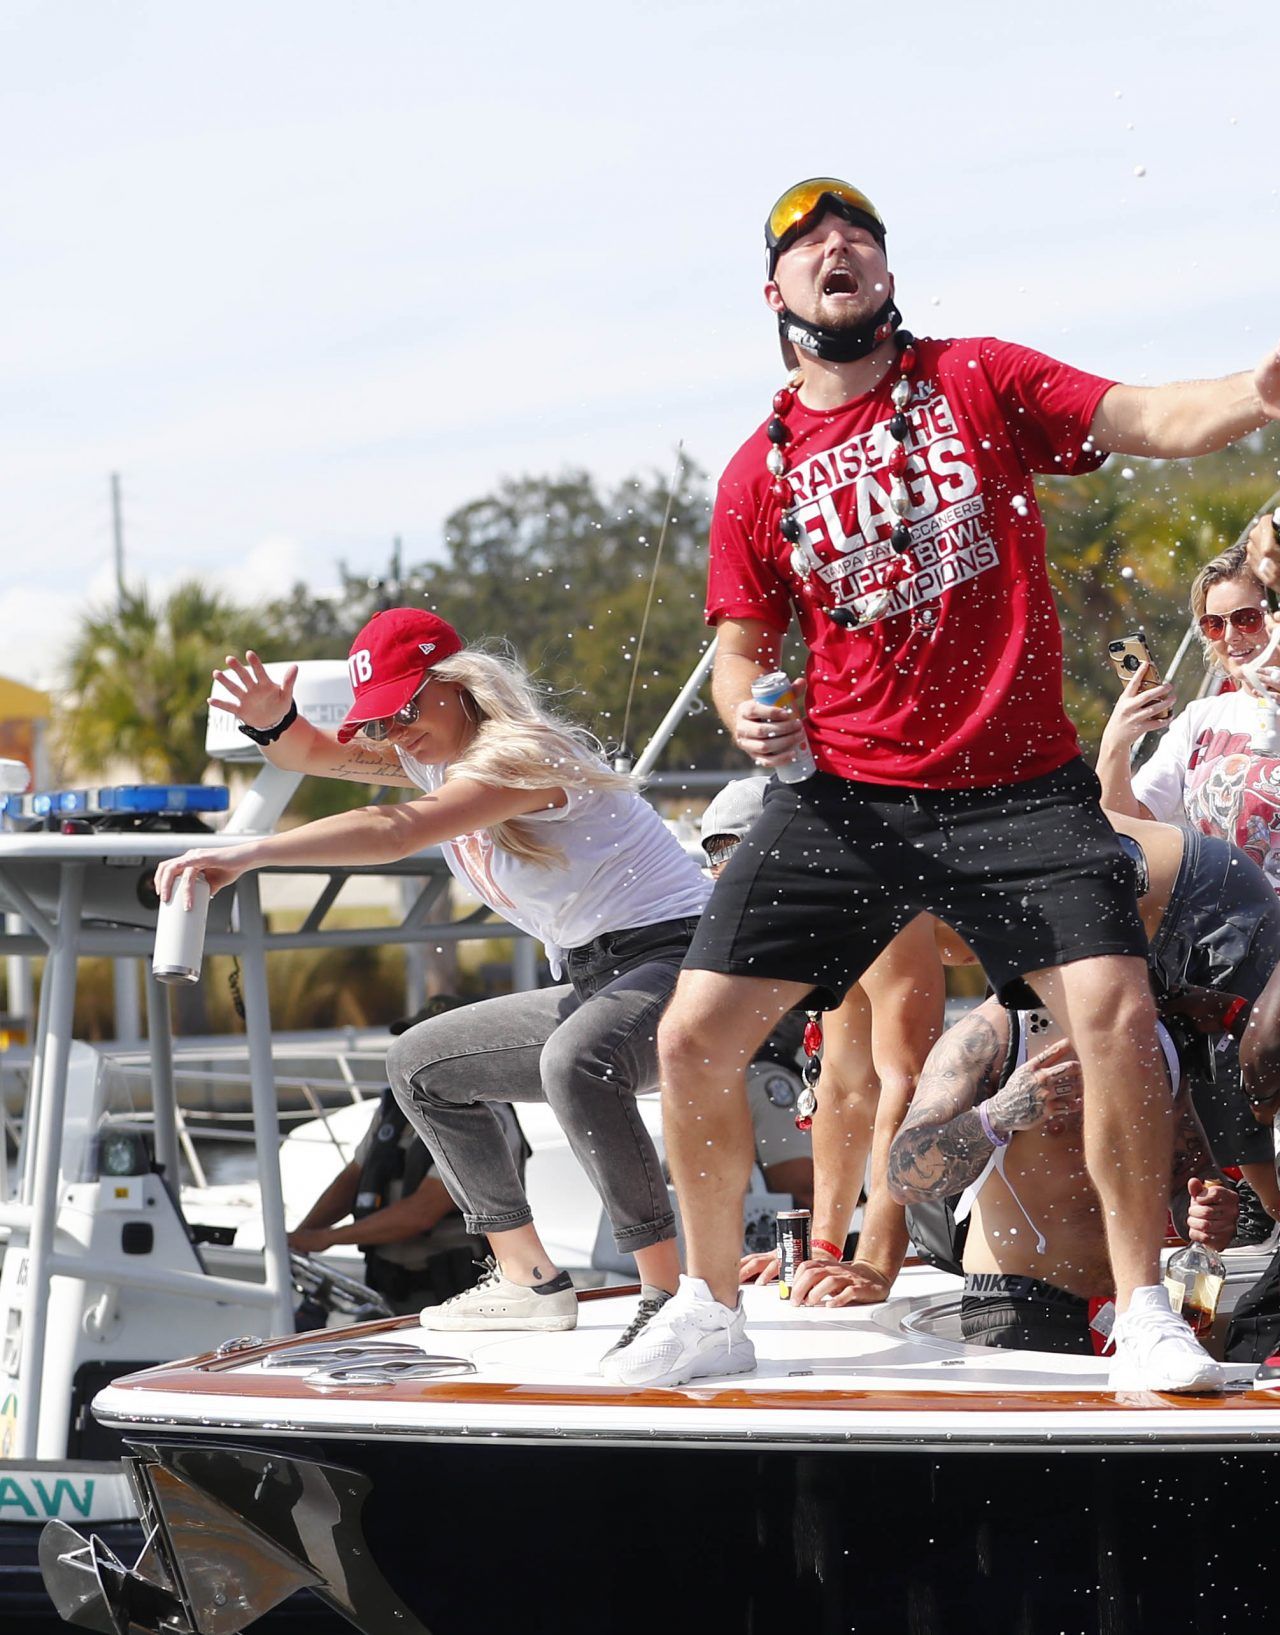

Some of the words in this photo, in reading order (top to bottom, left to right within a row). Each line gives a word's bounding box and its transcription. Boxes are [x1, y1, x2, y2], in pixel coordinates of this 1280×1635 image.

[786, 436, 883, 501] RAISE
[884, 400, 951, 452] HE
[791, 438, 978, 570] FLAGS
[821, 555, 863, 579] TAMPA
[864, 543, 892, 563] BAY
[910, 502, 982, 541] CCANEERS
[914, 519, 988, 567] BOWL
[851, 544, 994, 618] MPIONS
[349, 649, 373, 688] TB
[970, 1274, 1022, 1292] NIKE
